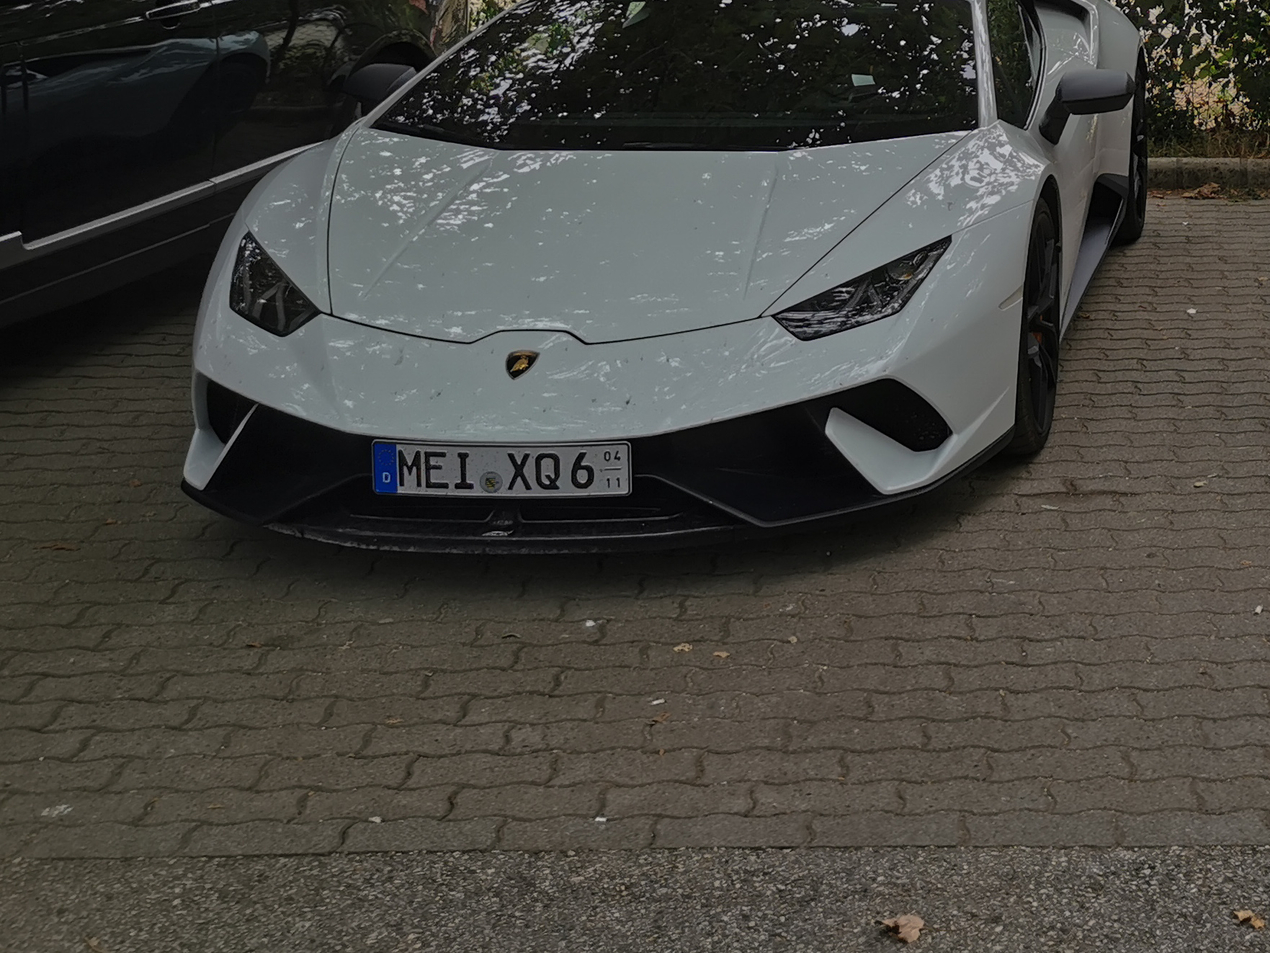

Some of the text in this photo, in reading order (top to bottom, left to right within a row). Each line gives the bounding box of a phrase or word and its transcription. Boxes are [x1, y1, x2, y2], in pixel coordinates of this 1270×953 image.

[604, 451, 621, 462] 04
[398, 450, 474, 490] MEI
[382, 472, 391, 483] D
[606, 478, 621, 488] 11
